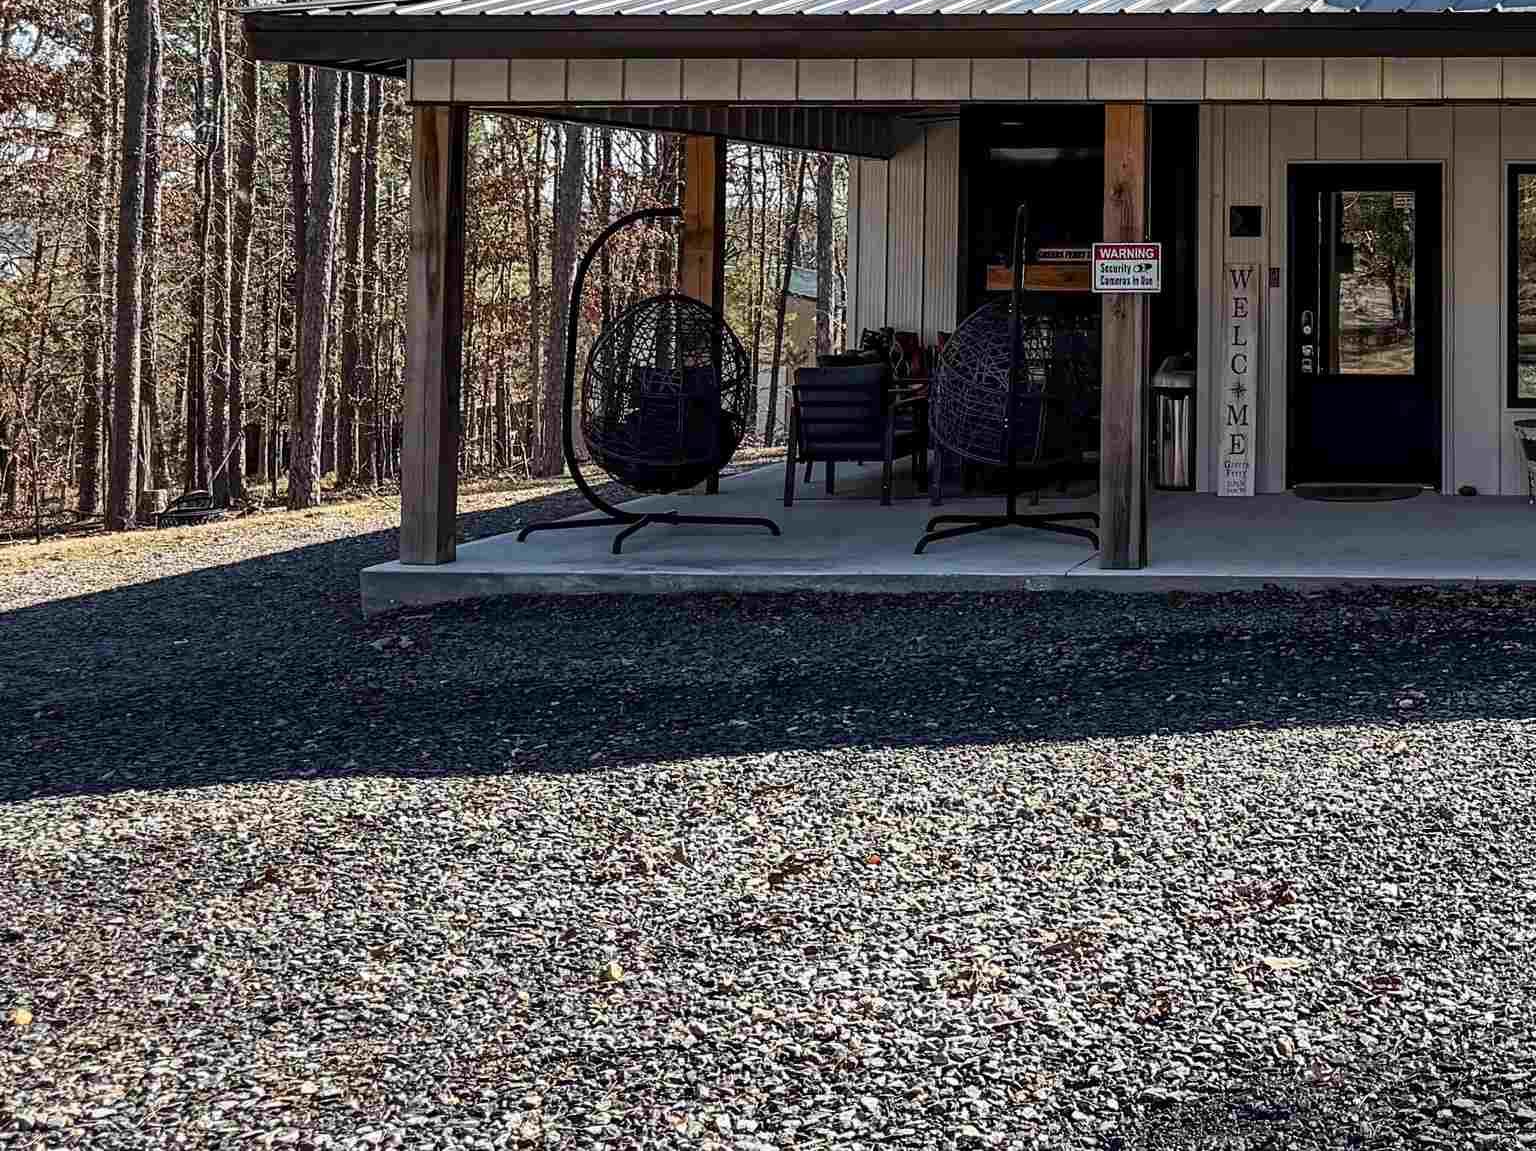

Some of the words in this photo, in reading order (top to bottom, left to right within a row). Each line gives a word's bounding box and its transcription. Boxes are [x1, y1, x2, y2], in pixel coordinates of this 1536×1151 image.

[1099, 247, 1155, 259] WARNING
[1100, 263, 1131, 275] Security
[1100, 275, 1130, 286] Cameras
[1226, 269, 1252, 455] WELCME
